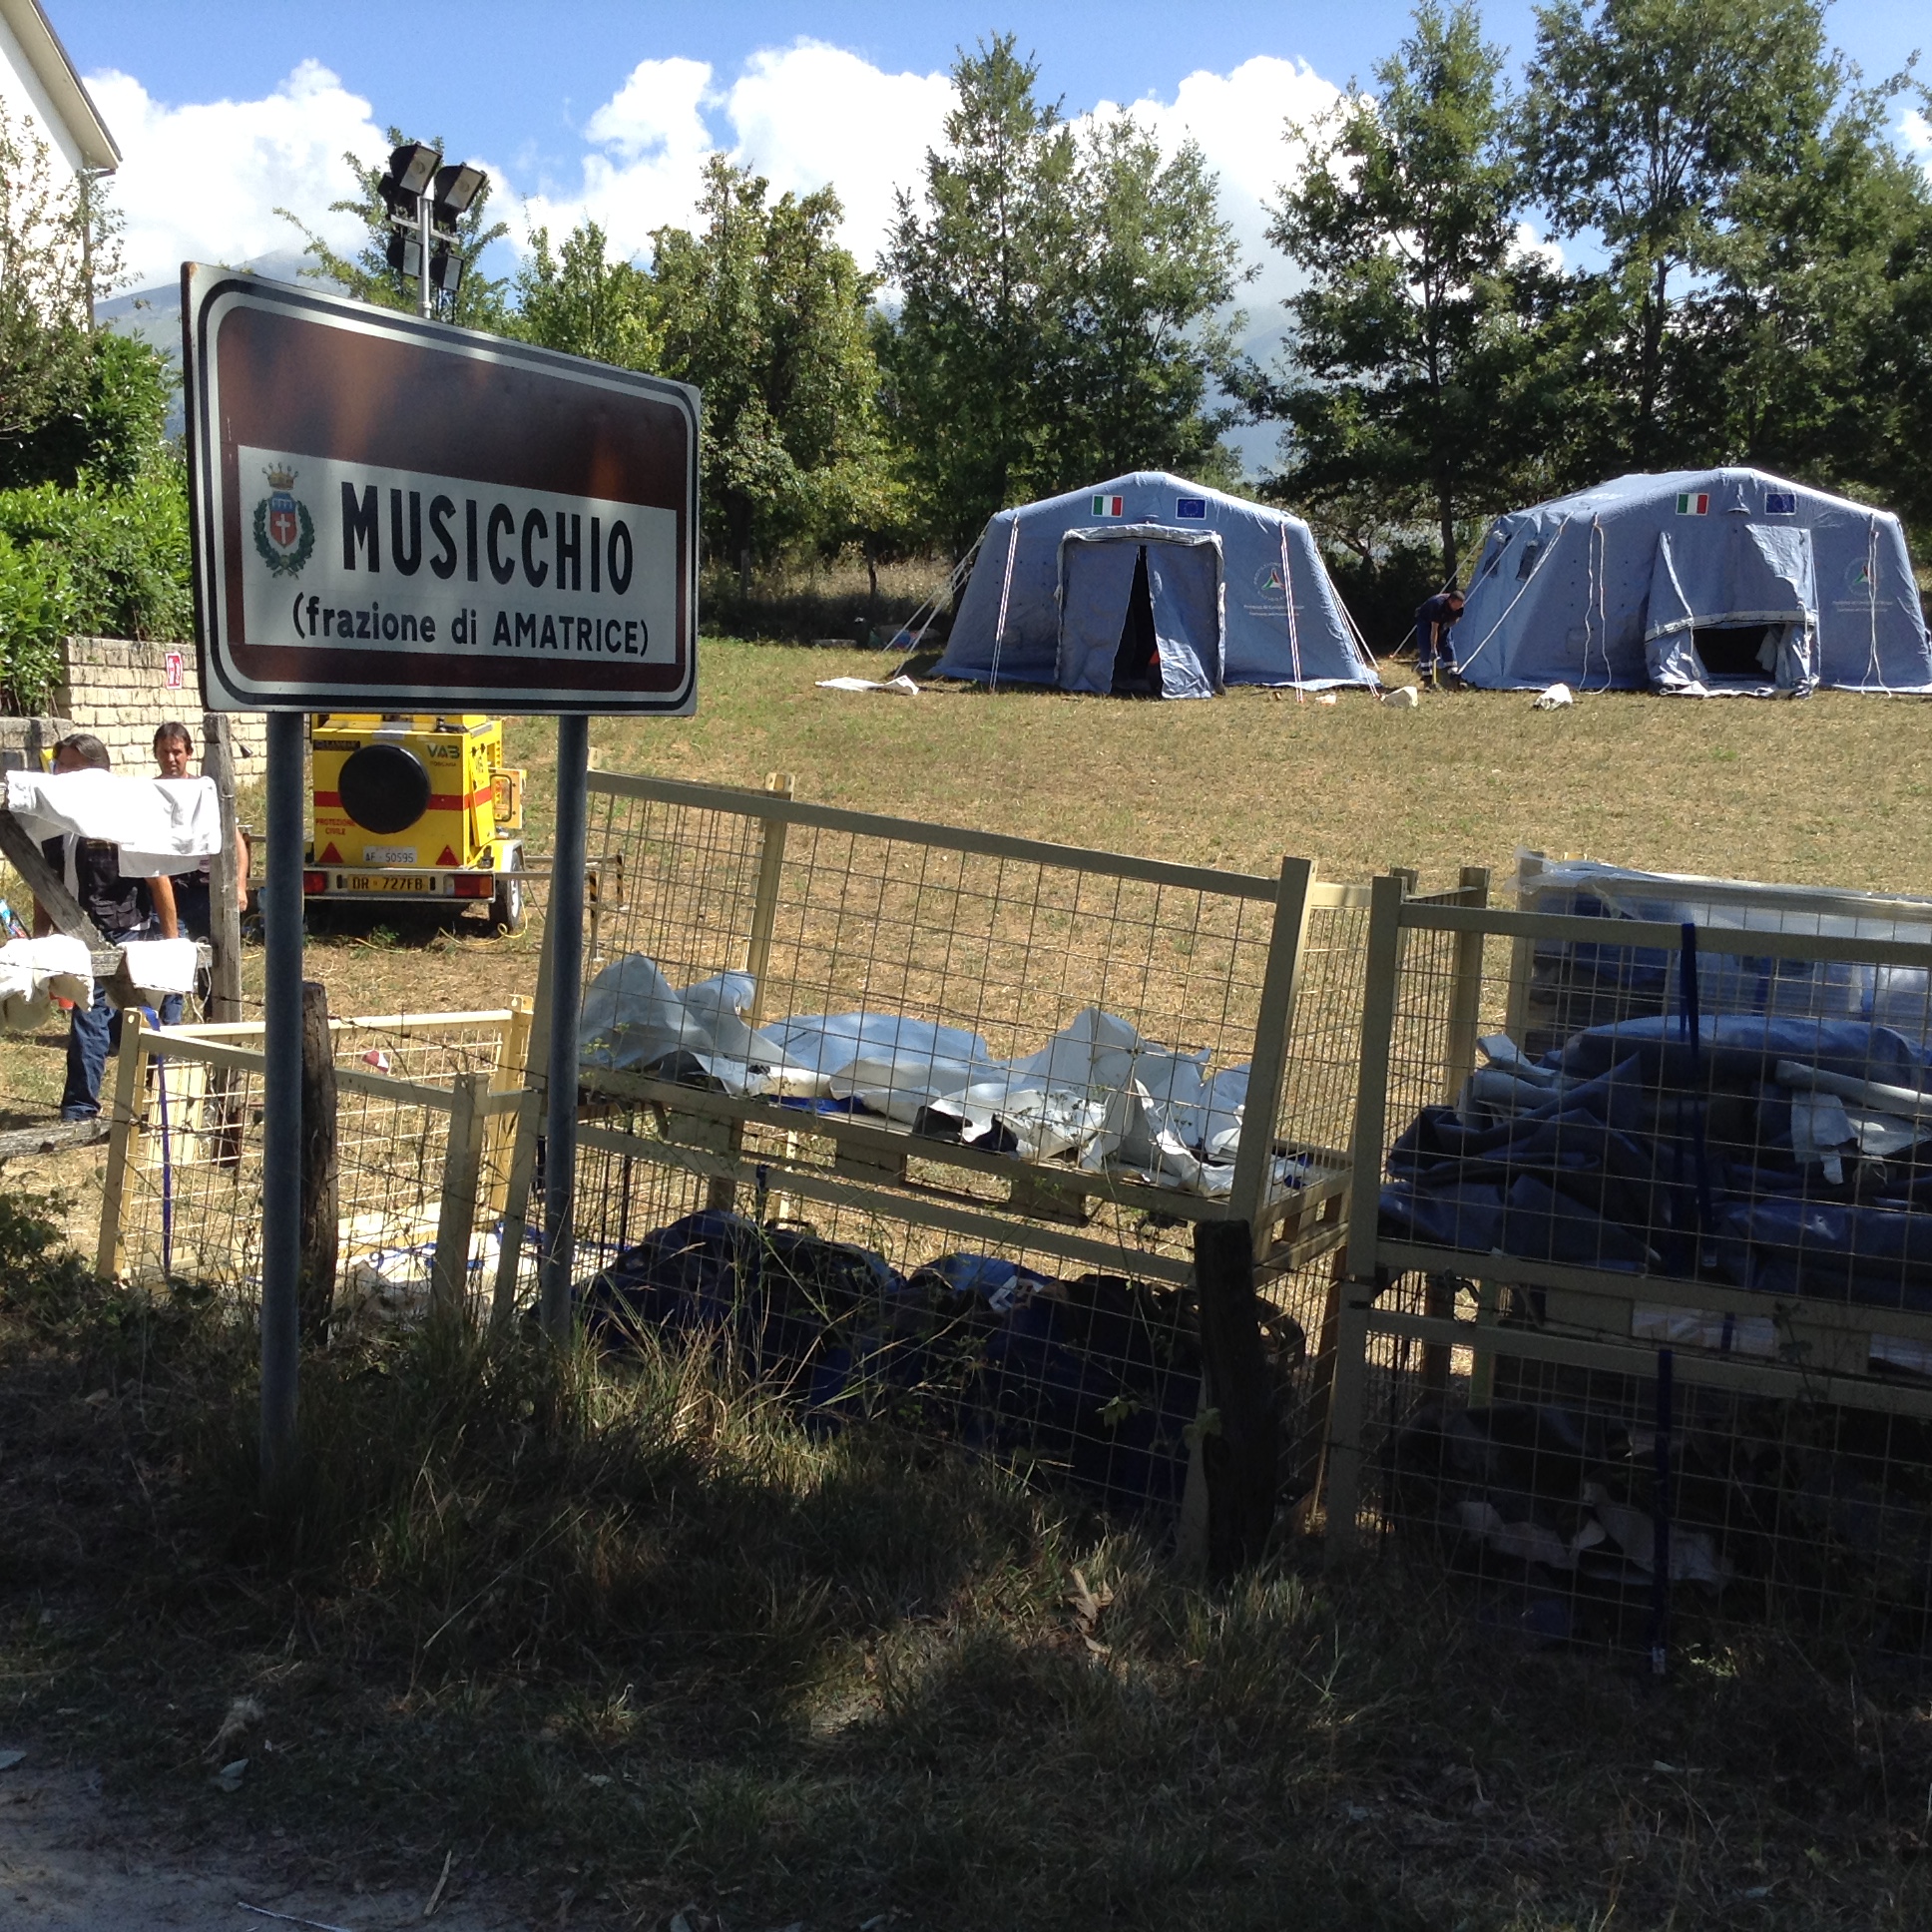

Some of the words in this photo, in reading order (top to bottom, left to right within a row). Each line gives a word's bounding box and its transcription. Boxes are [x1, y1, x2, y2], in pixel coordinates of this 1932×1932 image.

[341, 481, 634, 595] MUSICCHIO
[292, 592, 436, 644] (frazione
[451, 608, 477, 645] di
[492, 611, 649, 658] AMATRICE)
[427, 744, 460, 759] VAB
